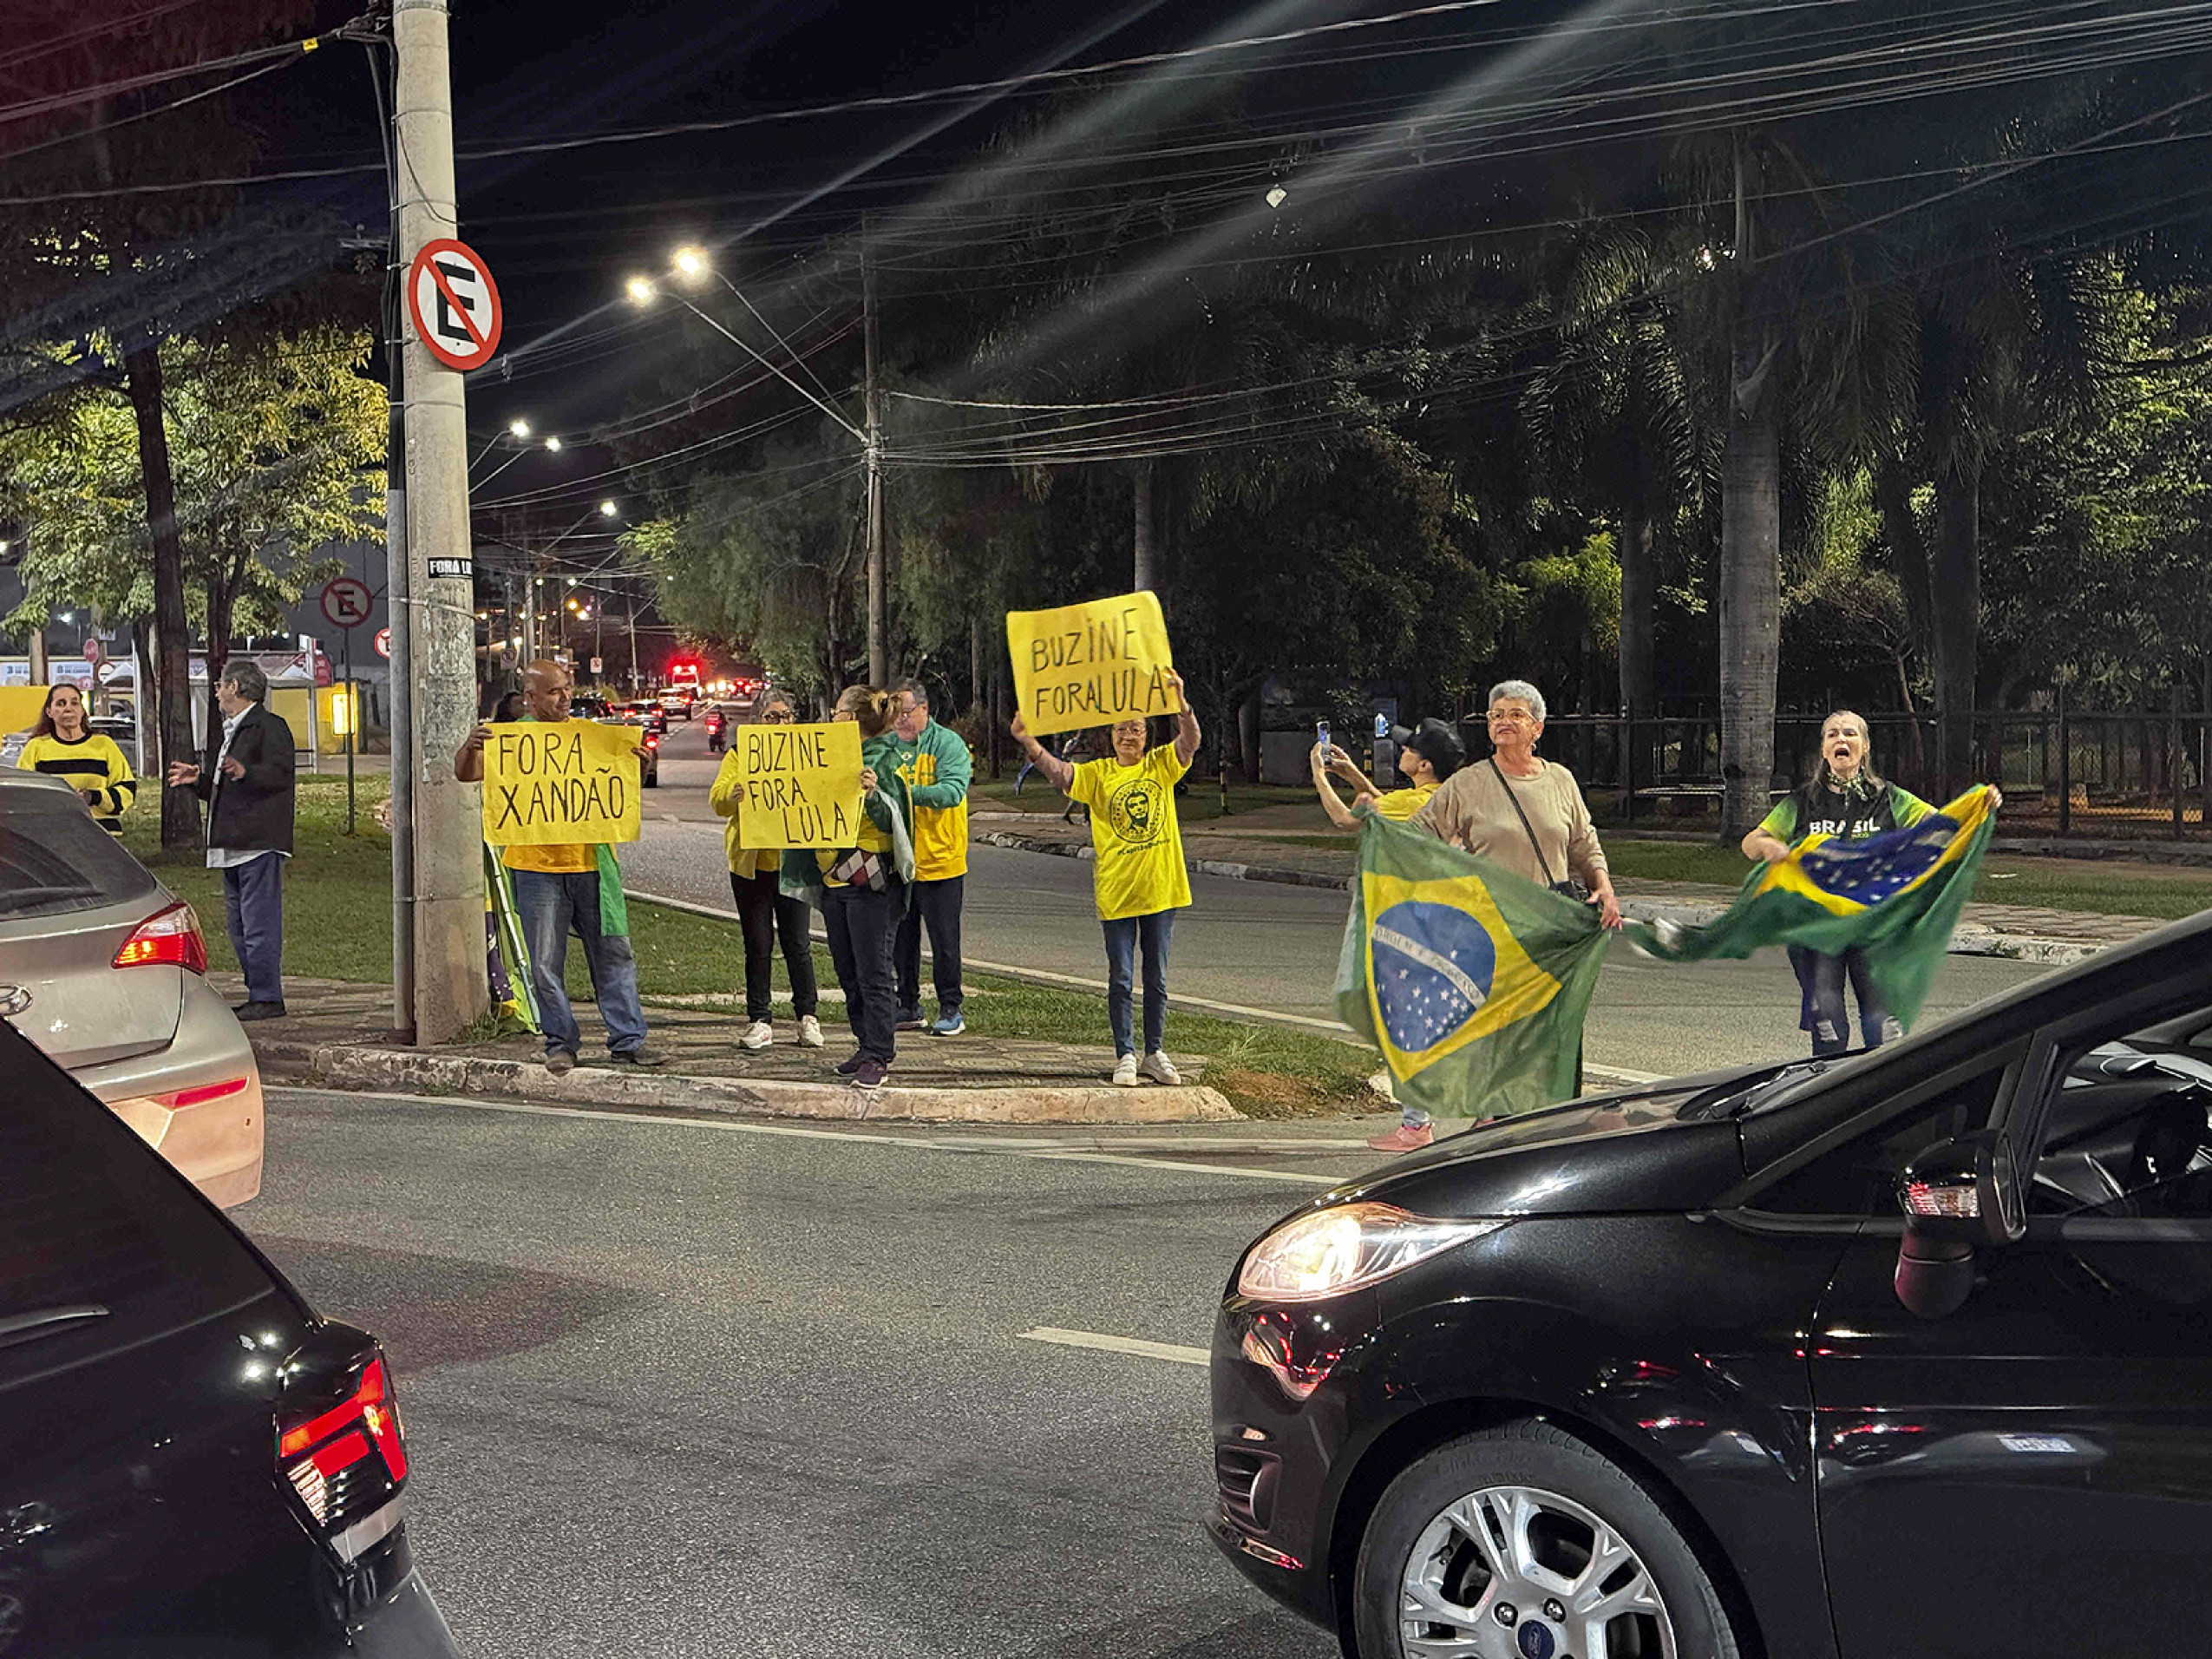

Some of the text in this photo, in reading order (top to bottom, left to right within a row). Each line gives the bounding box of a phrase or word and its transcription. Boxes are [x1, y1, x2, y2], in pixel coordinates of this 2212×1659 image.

[429, 561, 460, 574] FORA
[499, 732, 586, 777] FORA
[748, 731, 828, 775] BUZINE
[495, 765, 625, 830] XANDÃO
[748, 777, 808, 812] FORA
